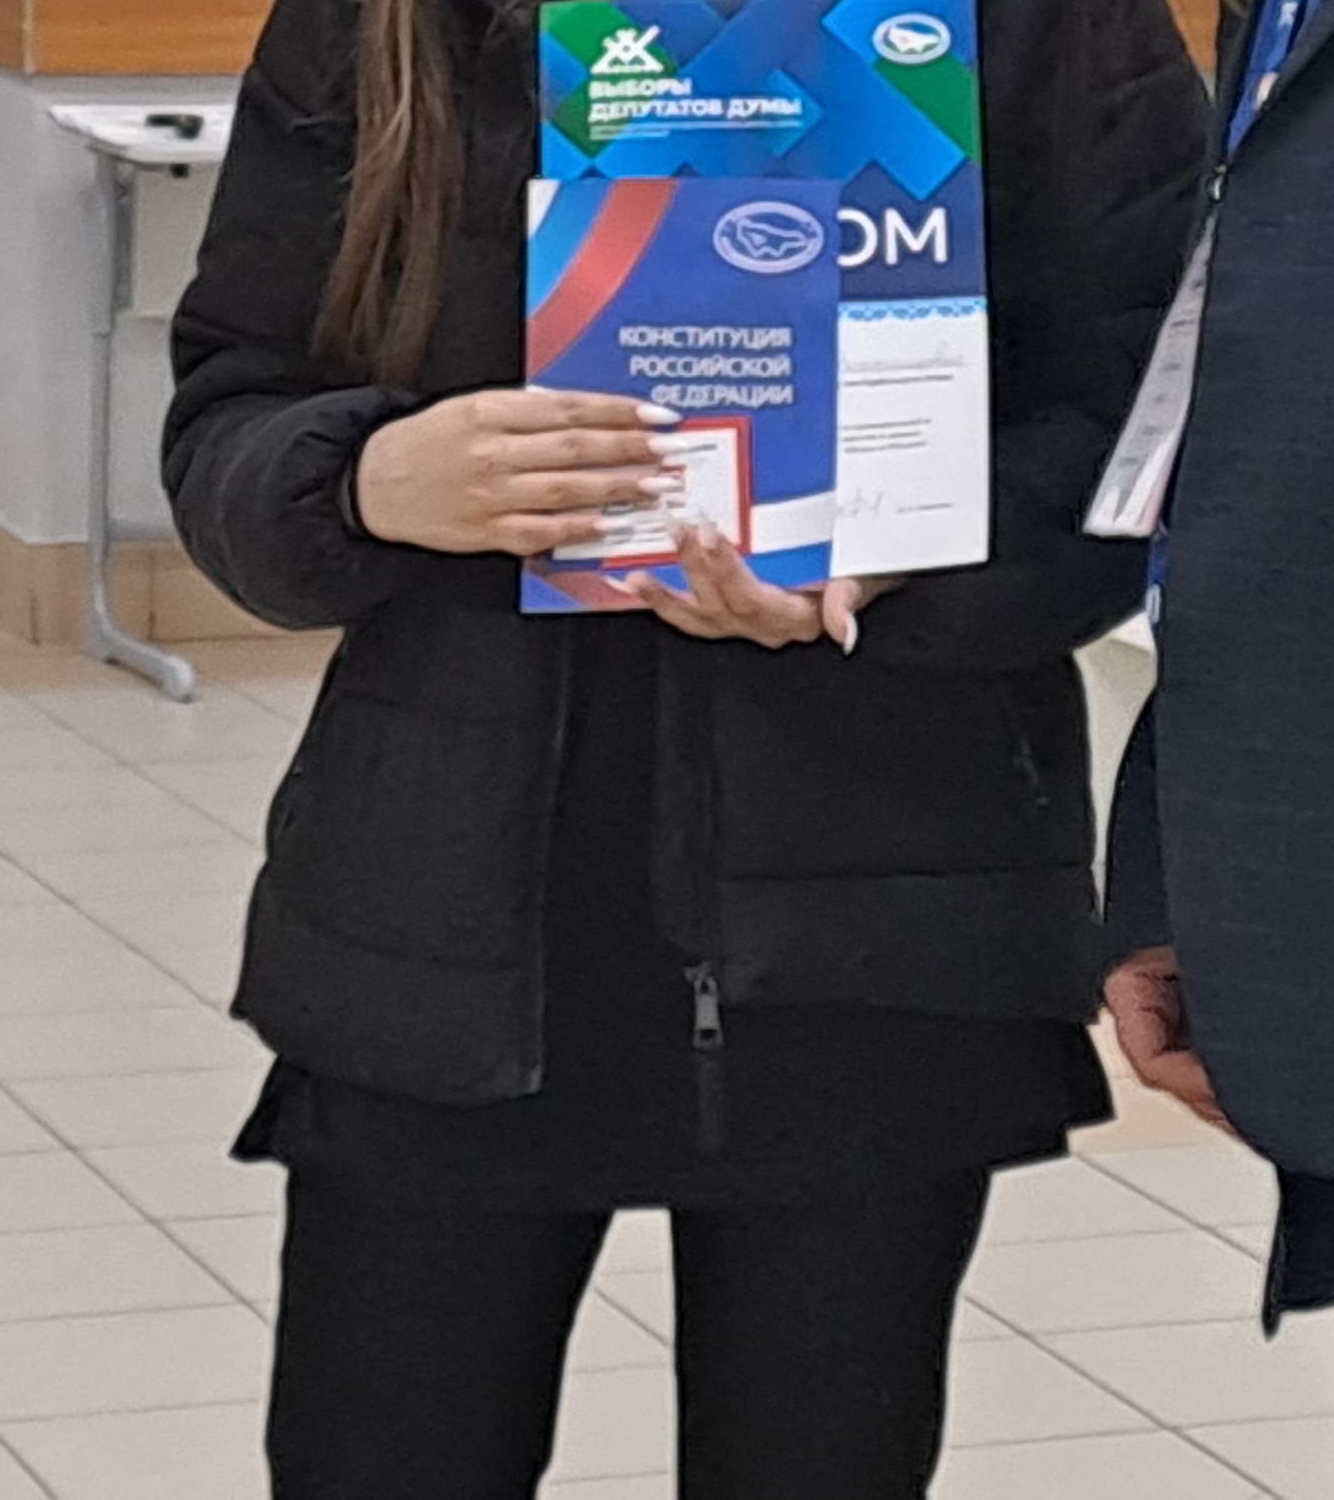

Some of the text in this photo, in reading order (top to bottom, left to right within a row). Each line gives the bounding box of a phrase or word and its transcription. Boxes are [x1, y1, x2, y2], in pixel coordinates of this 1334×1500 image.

[589, 77, 693, 99] ВЫБОРЫ
[588, 97, 803, 122] ДЕПУТАТОВ ДУМЫ
[619, 325, 793, 350] КОНСТИТУЦИЯ
[629, 353, 792, 377] РОССИЙСКОЙ
[650, 383, 794, 409] ФЕДЕРАЦИИ
